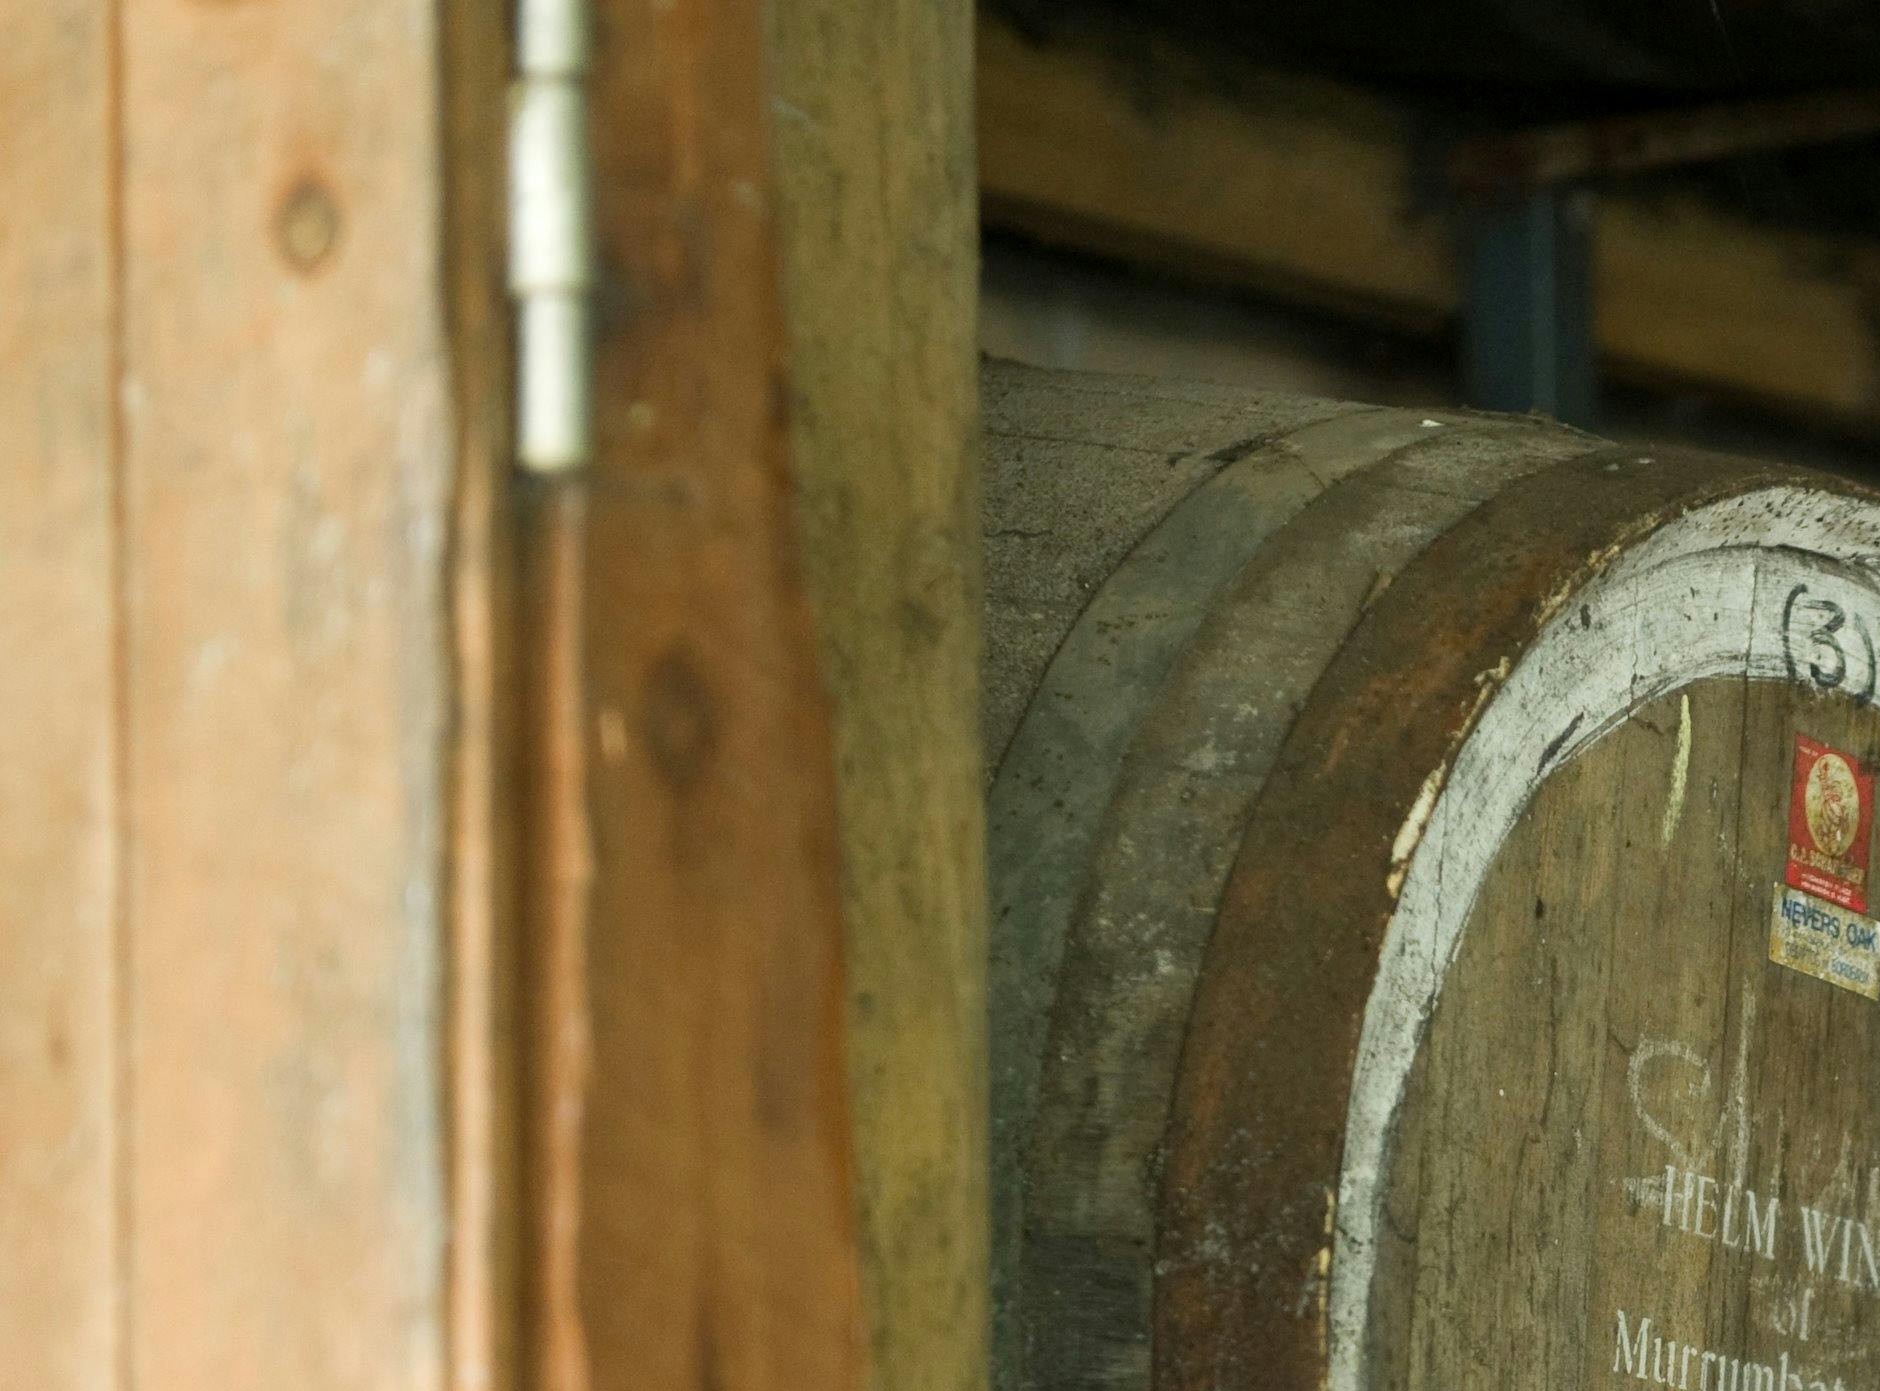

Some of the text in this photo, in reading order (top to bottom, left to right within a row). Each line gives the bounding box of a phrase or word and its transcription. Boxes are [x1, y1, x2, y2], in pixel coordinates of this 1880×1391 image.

[1846, 922, 1877, 953] OAK
[1662, 1165, 1779, 1260] HELM
[1771, 1287, 1815, 1342] of
